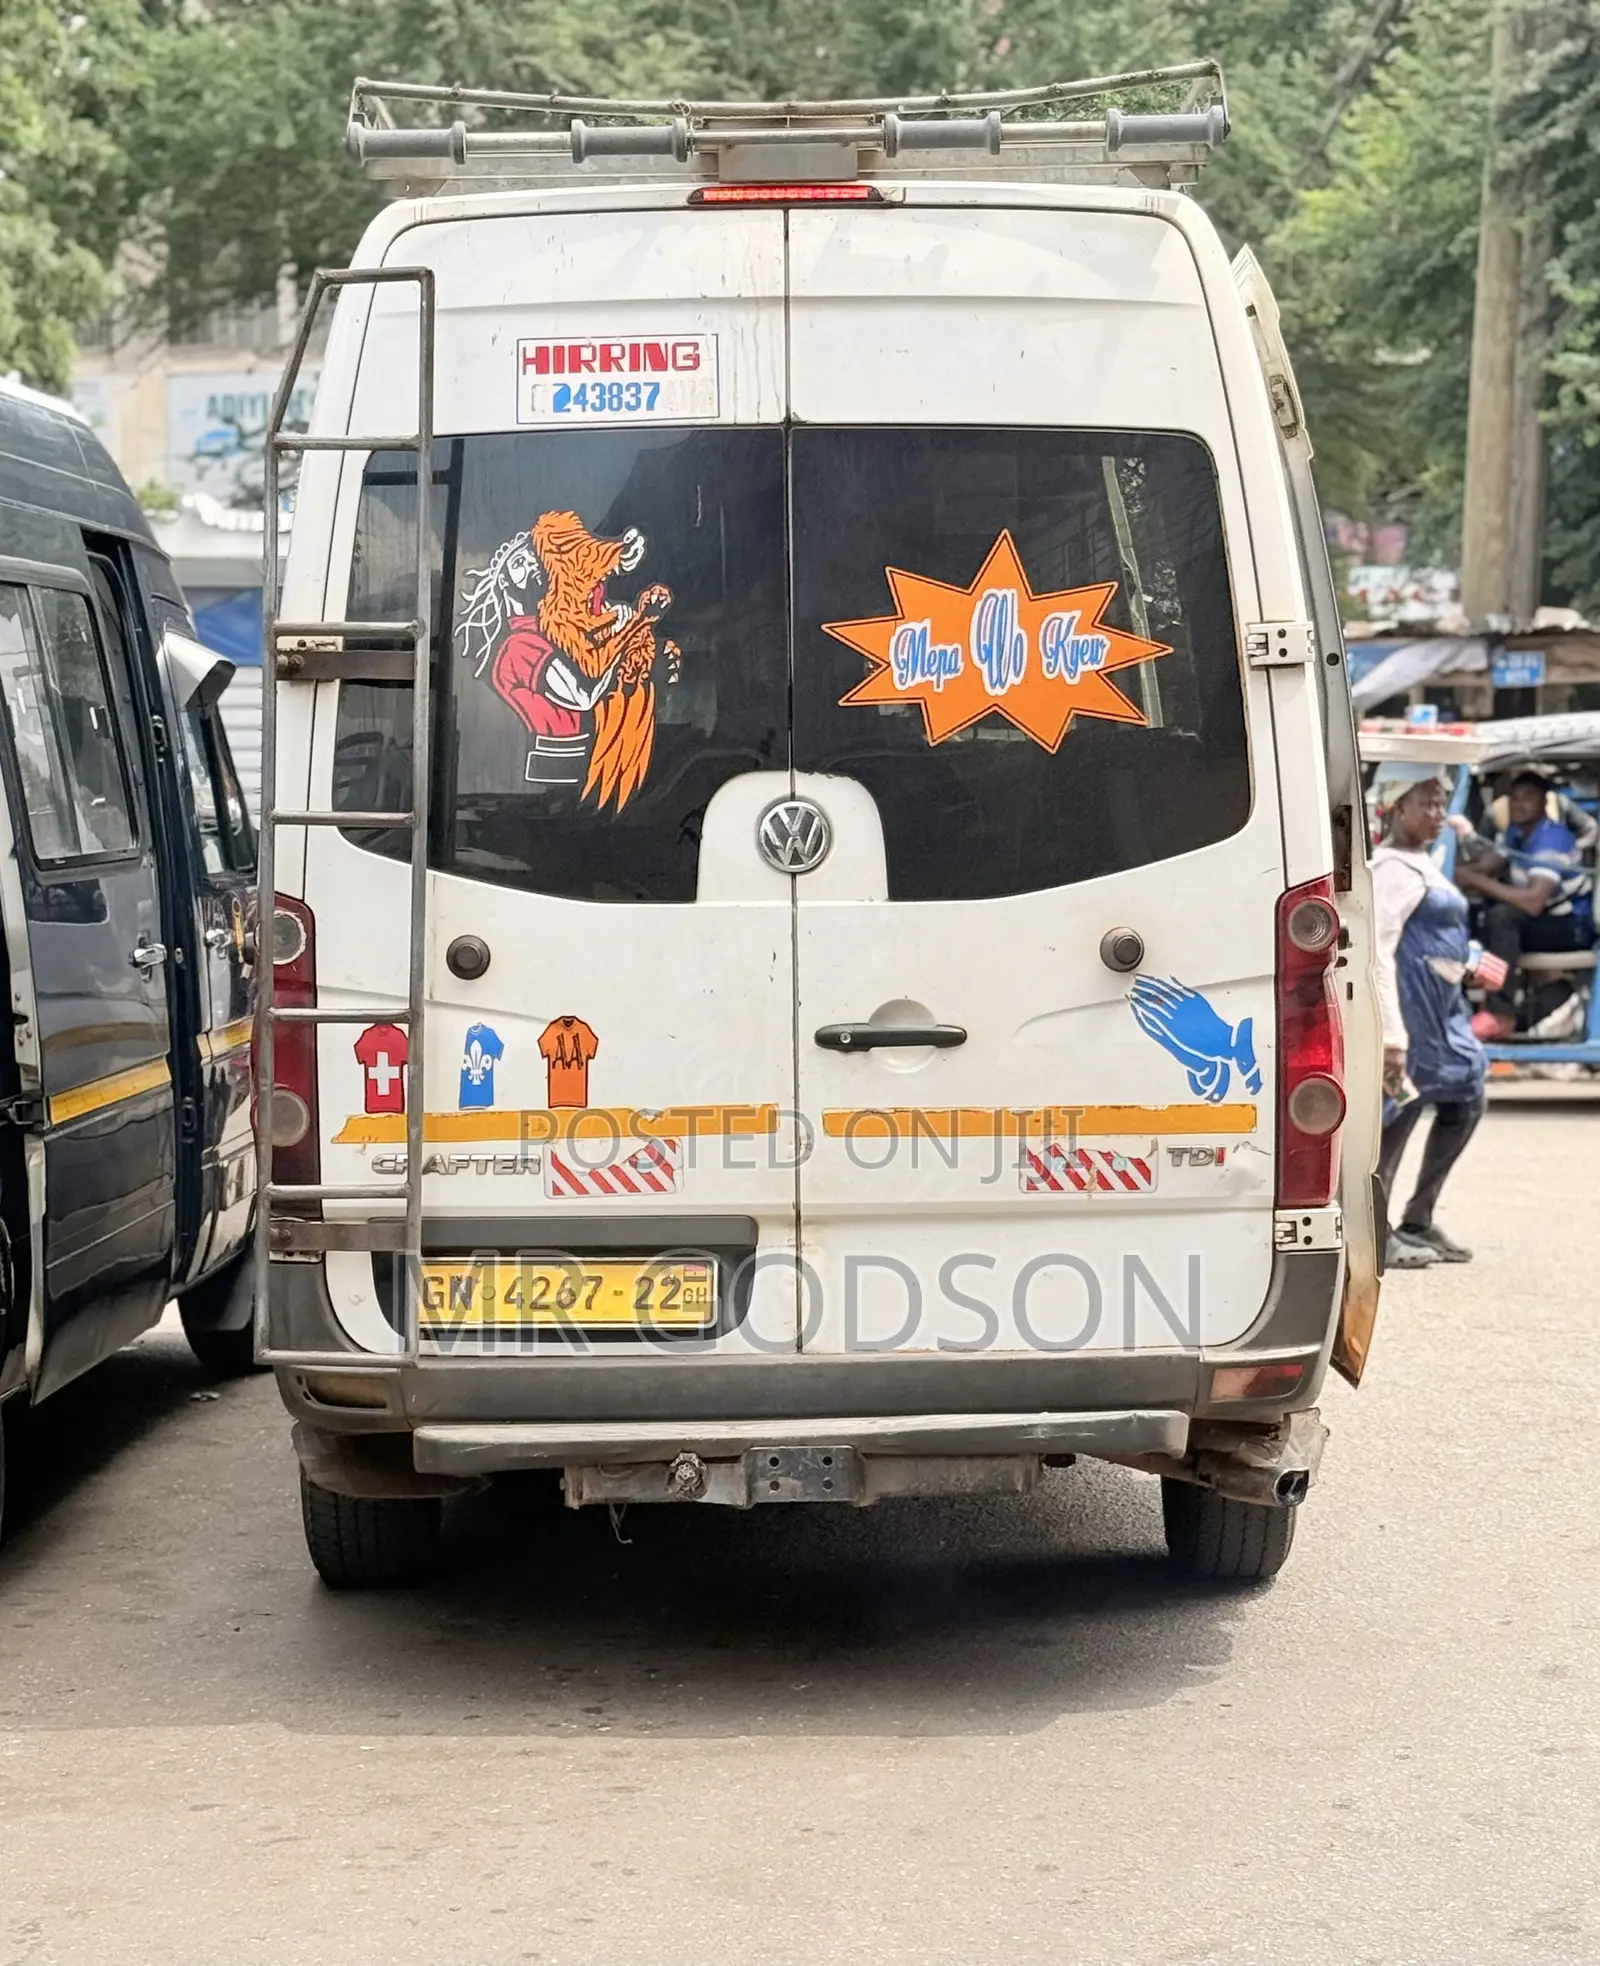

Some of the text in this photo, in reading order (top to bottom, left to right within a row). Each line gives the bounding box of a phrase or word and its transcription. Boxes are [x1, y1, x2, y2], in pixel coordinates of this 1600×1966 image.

[522, 342, 700, 375] HIRRING
[553, 382, 661, 413] 243837
[893, 624, 962, 690] Mepa
[1041, 615, 1108, 680] Kyew
[1166, 1145, 1226, 1167] TDI
[504, 1275, 603, 1311] 4267
[634, 1275, 682, 1311] 22
[683, 1287, 707, 1305] GH
